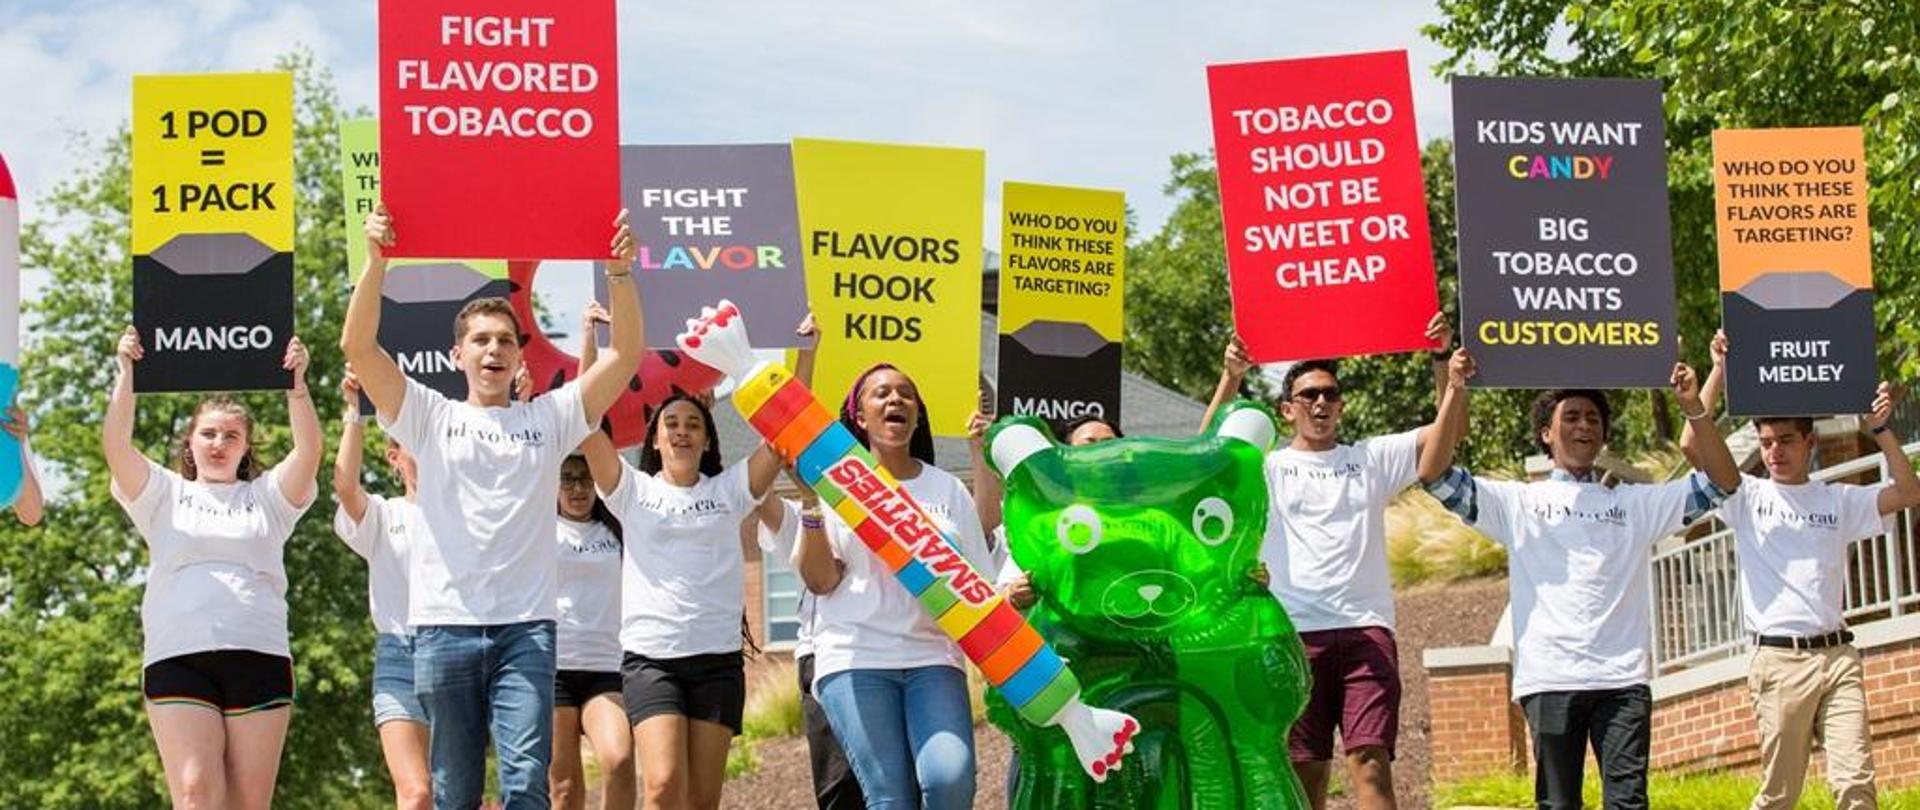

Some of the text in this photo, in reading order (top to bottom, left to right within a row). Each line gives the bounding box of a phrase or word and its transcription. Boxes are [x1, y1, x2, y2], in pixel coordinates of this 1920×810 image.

[442, 16, 554, 46] FIGHT
[399, 60, 598, 92] FLAVORED
[161, 110, 267, 139] 1 POD
[405, 106, 592, 137] TOBACCO
[1233, 99, 1392, 135] TOBACCO
[1478, 121, 1641, 145] KIDS WANT
[1251, 139, 1384, 173] SHOULD
[1509, 156, 1611, 178] CANDY
[1723, 159, 1855, 176] WHO DO YOU
[153, 183, 275, 212] 1 PACK
[643, 189, 747, 207] FIGHT
[1265, 177, 1380, 211] NOT BE
[1728, 181, 1853, 198] THINK THESE
[1010, 212, 1117, 234] WHO DO YOU
[1727, 203, 1856, 220] FLAVORS ARE
[662, 216, 732, 235] THE
[1245, 214, 1409, 252] SWEET OR
[1540, 218, 1588, 241] BIG
[1734, 226, 1853, 243] TARGETING?
[813, 231, 959, 264] FLAVORS
[1012, 233, 1113, 255] THINK THESE
[640, 246, 785, 269] LAVOR
[1009, 255, 1115, 276] FLAVORS ARE
[1493, 252, 1637, 275] TOBACCO
[1276, 255, 1386, 288] CHEAP
[834, 272, 934, 303] HOOK
[1013, 275, 1111, 296] TARGETING?
[1513, 287, 1622, 310] WANTS
[156, 325, 272, 351] MANGO
[846, 314, 921, 342] KIDS
[1480, 321, 1659, 345] CUSTOMERS
[1771, 341, 1830, 358] FRUIT
[397, 350, 456, 373] MIN
[1759, 364, 1843, 382] MEDLEY
[1013, 396, 1104, 420] MANGO
[828, 458, 996, 605] SMARTIES
